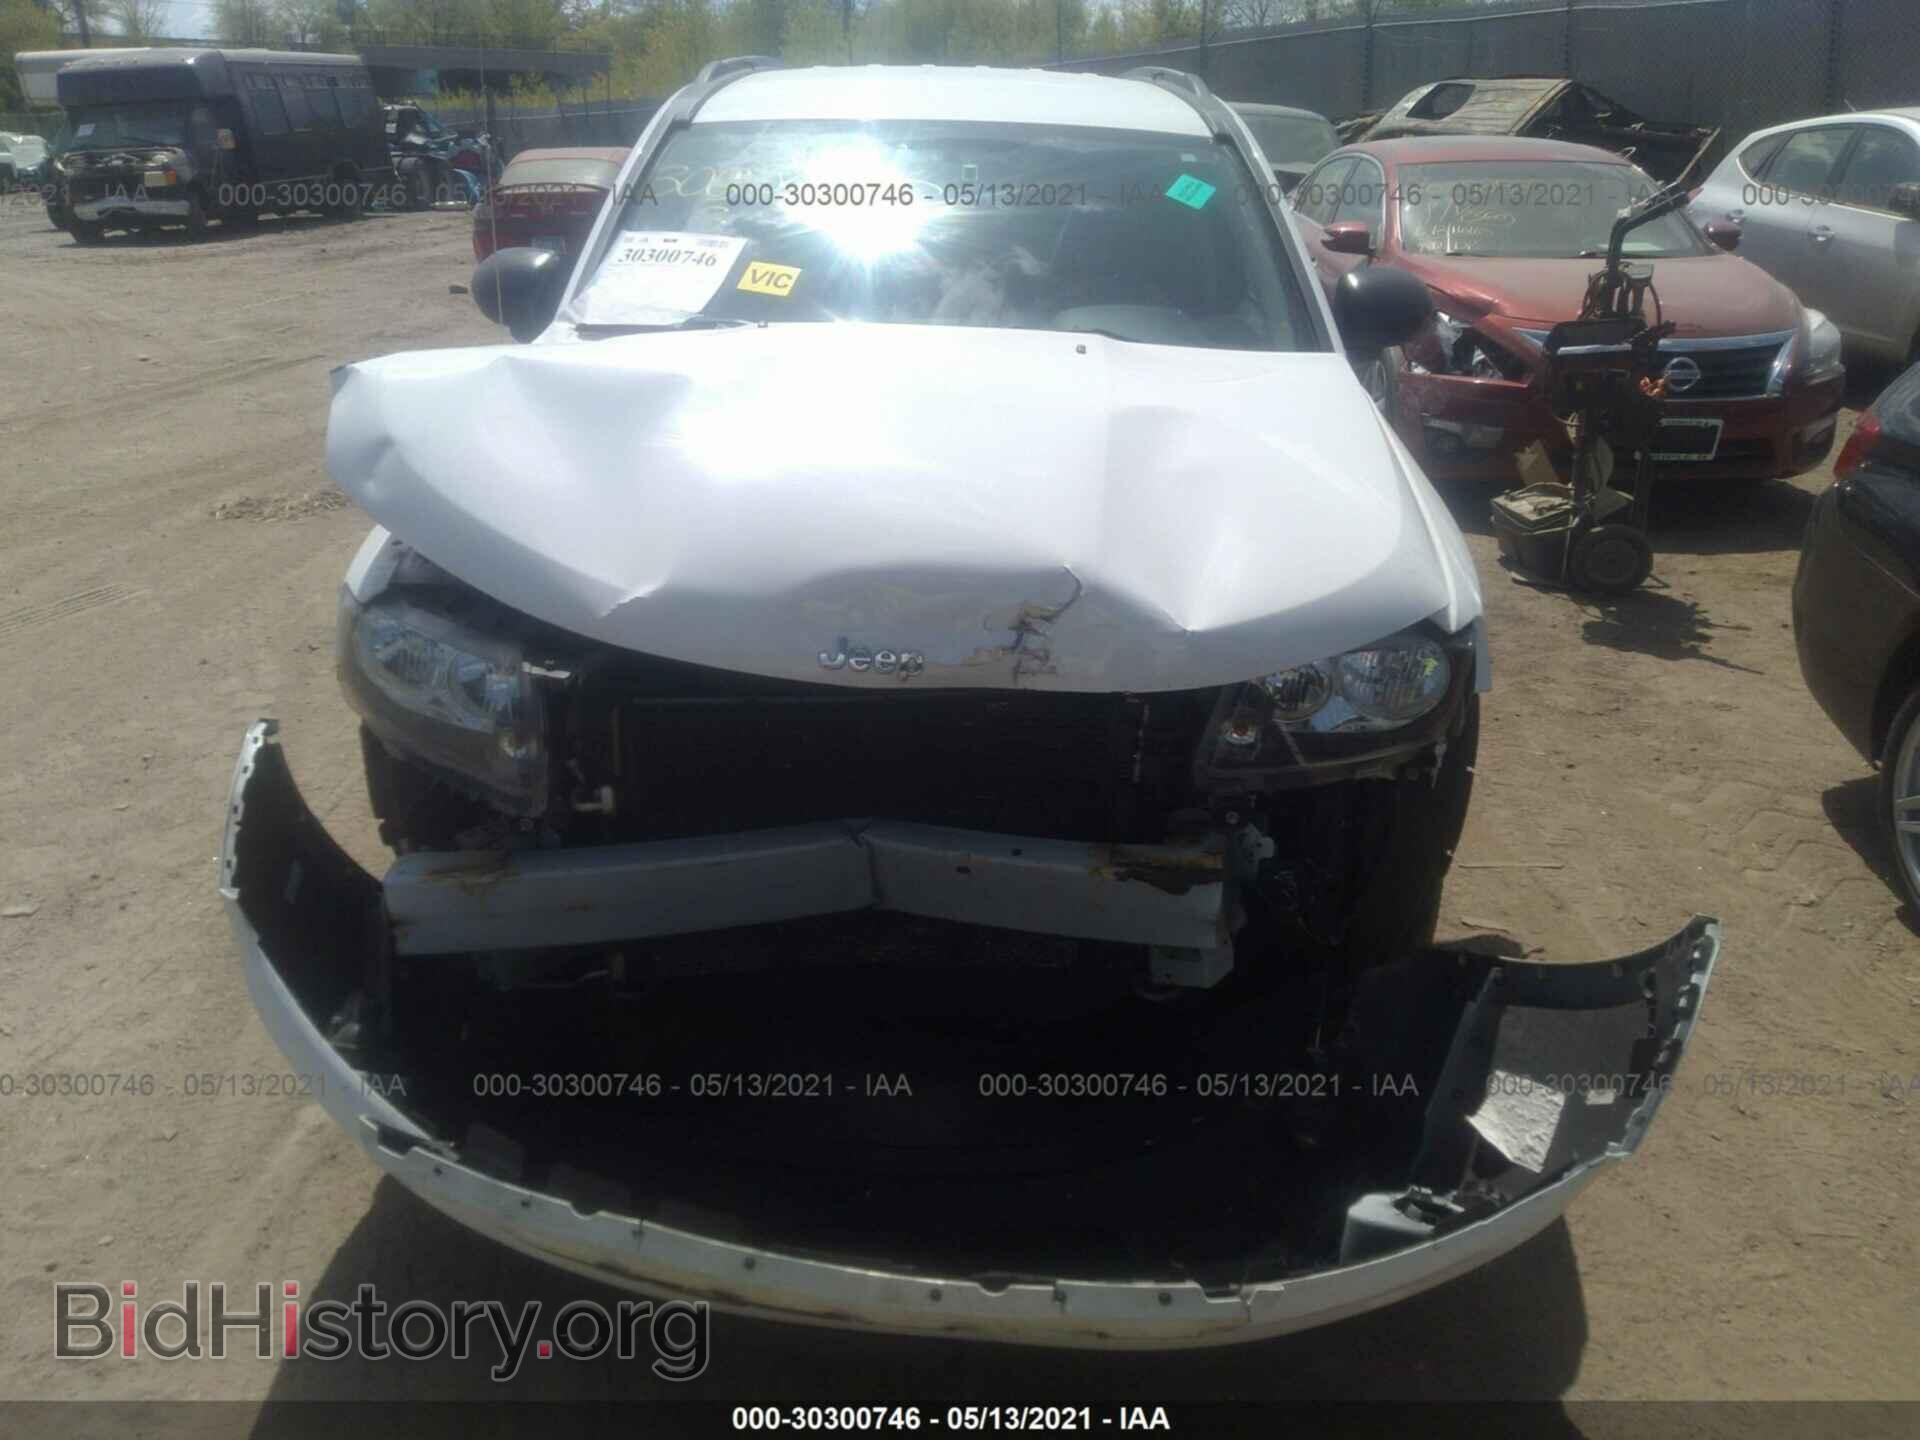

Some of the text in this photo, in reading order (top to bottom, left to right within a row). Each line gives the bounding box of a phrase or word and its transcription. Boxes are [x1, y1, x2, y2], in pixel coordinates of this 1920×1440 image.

[617, 247, 717, 267] 30300746
[751, 268, 793, 289] VIC
[816, 635, 925, 681] Jeep
